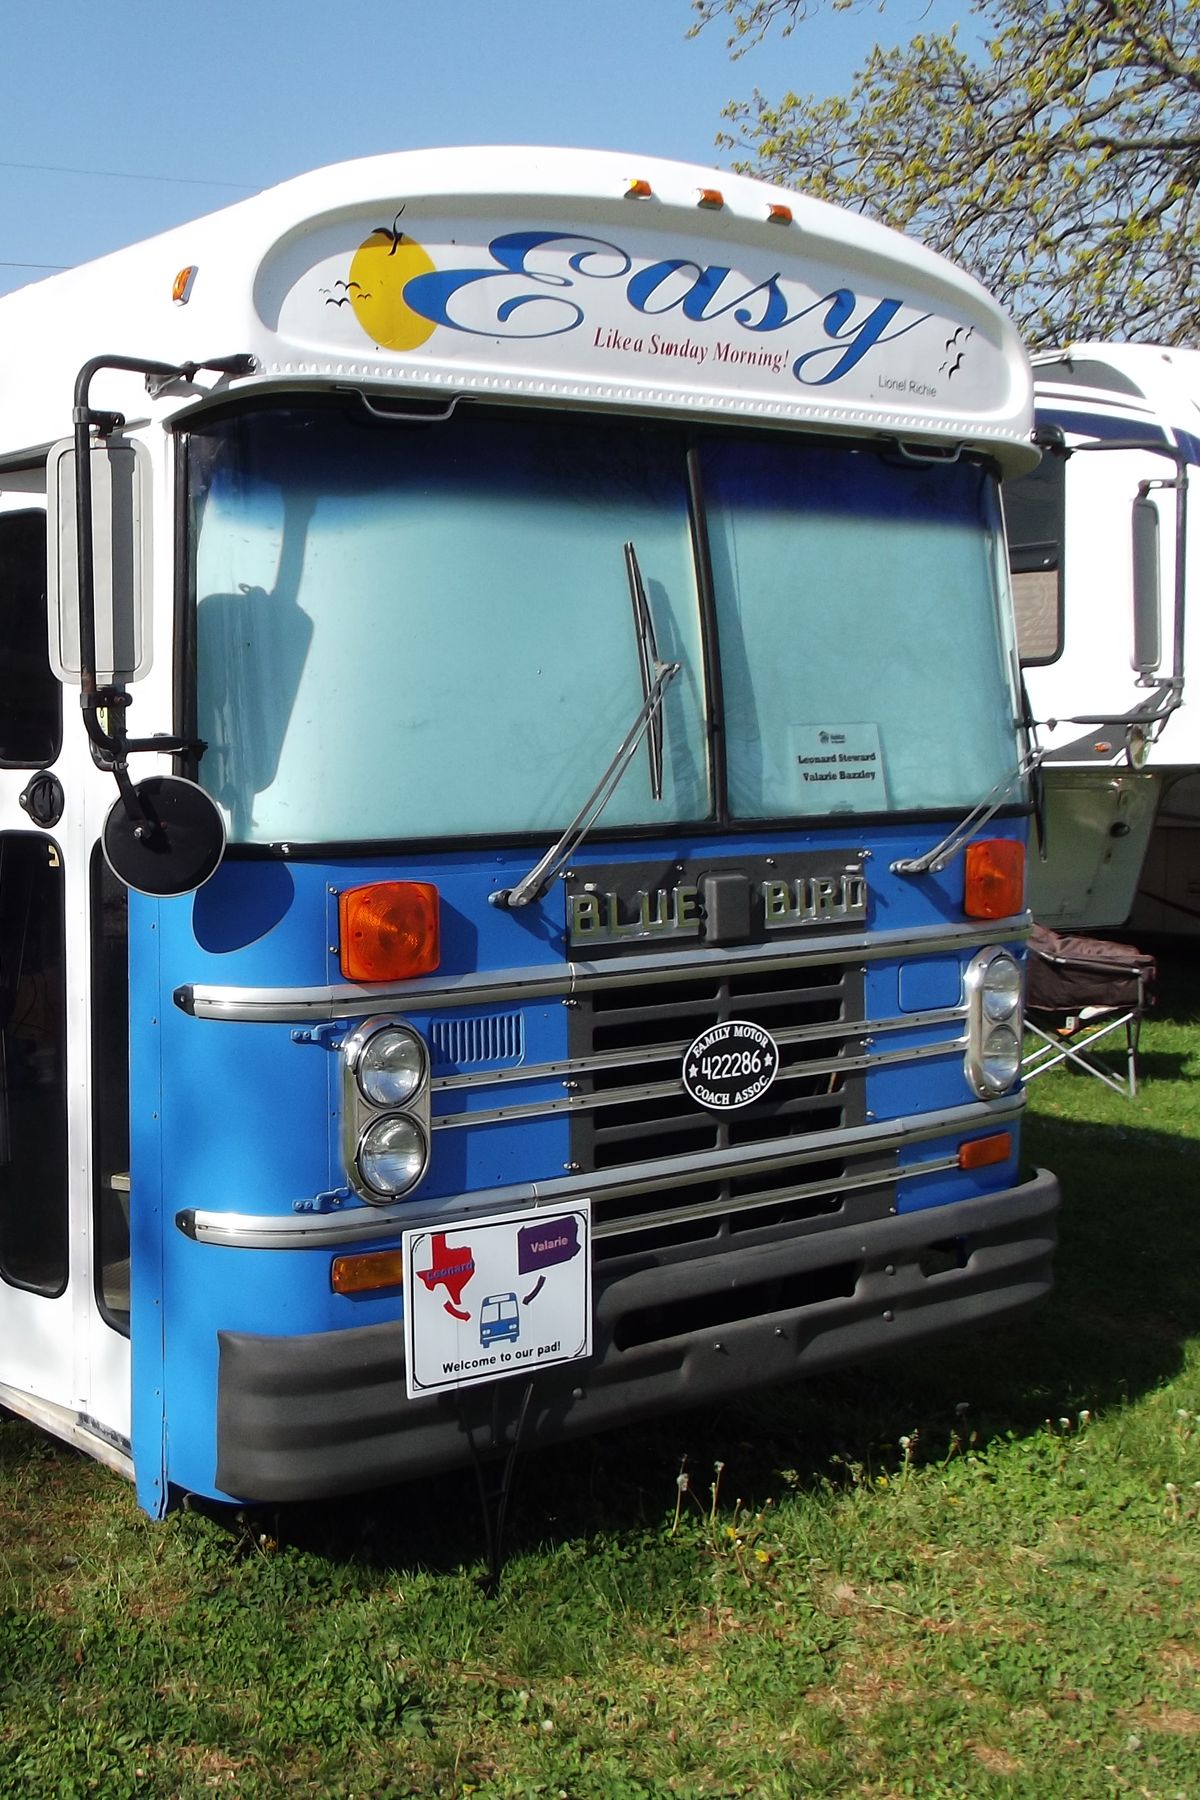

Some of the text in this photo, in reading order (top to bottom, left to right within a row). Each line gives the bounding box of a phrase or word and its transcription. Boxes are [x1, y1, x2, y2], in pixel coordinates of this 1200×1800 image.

[402, 231, 935, 386] Easy
[648, 333, 708, 365] Sunday
[712, 341, 790, 374] Morning!
[878, 374, 937, 398] Lionel Richie
[798, 752, 877, 764] Leonard Steward
[803, 771, 838, 782] Valarie
[567, 874, 868, 940] BLUE BIRD
[692, 1025, 769, 1058] FAMILY MOTOR
[701, 1049, 762, 1080] 422286
[694, 1084, 730, 1105] COACH
[530, 1235, 568, 1253] Valarie
[426, 1259, 474, 1281] Leonard
[442, 1341, 561, 1374] Welcome to our pad!
